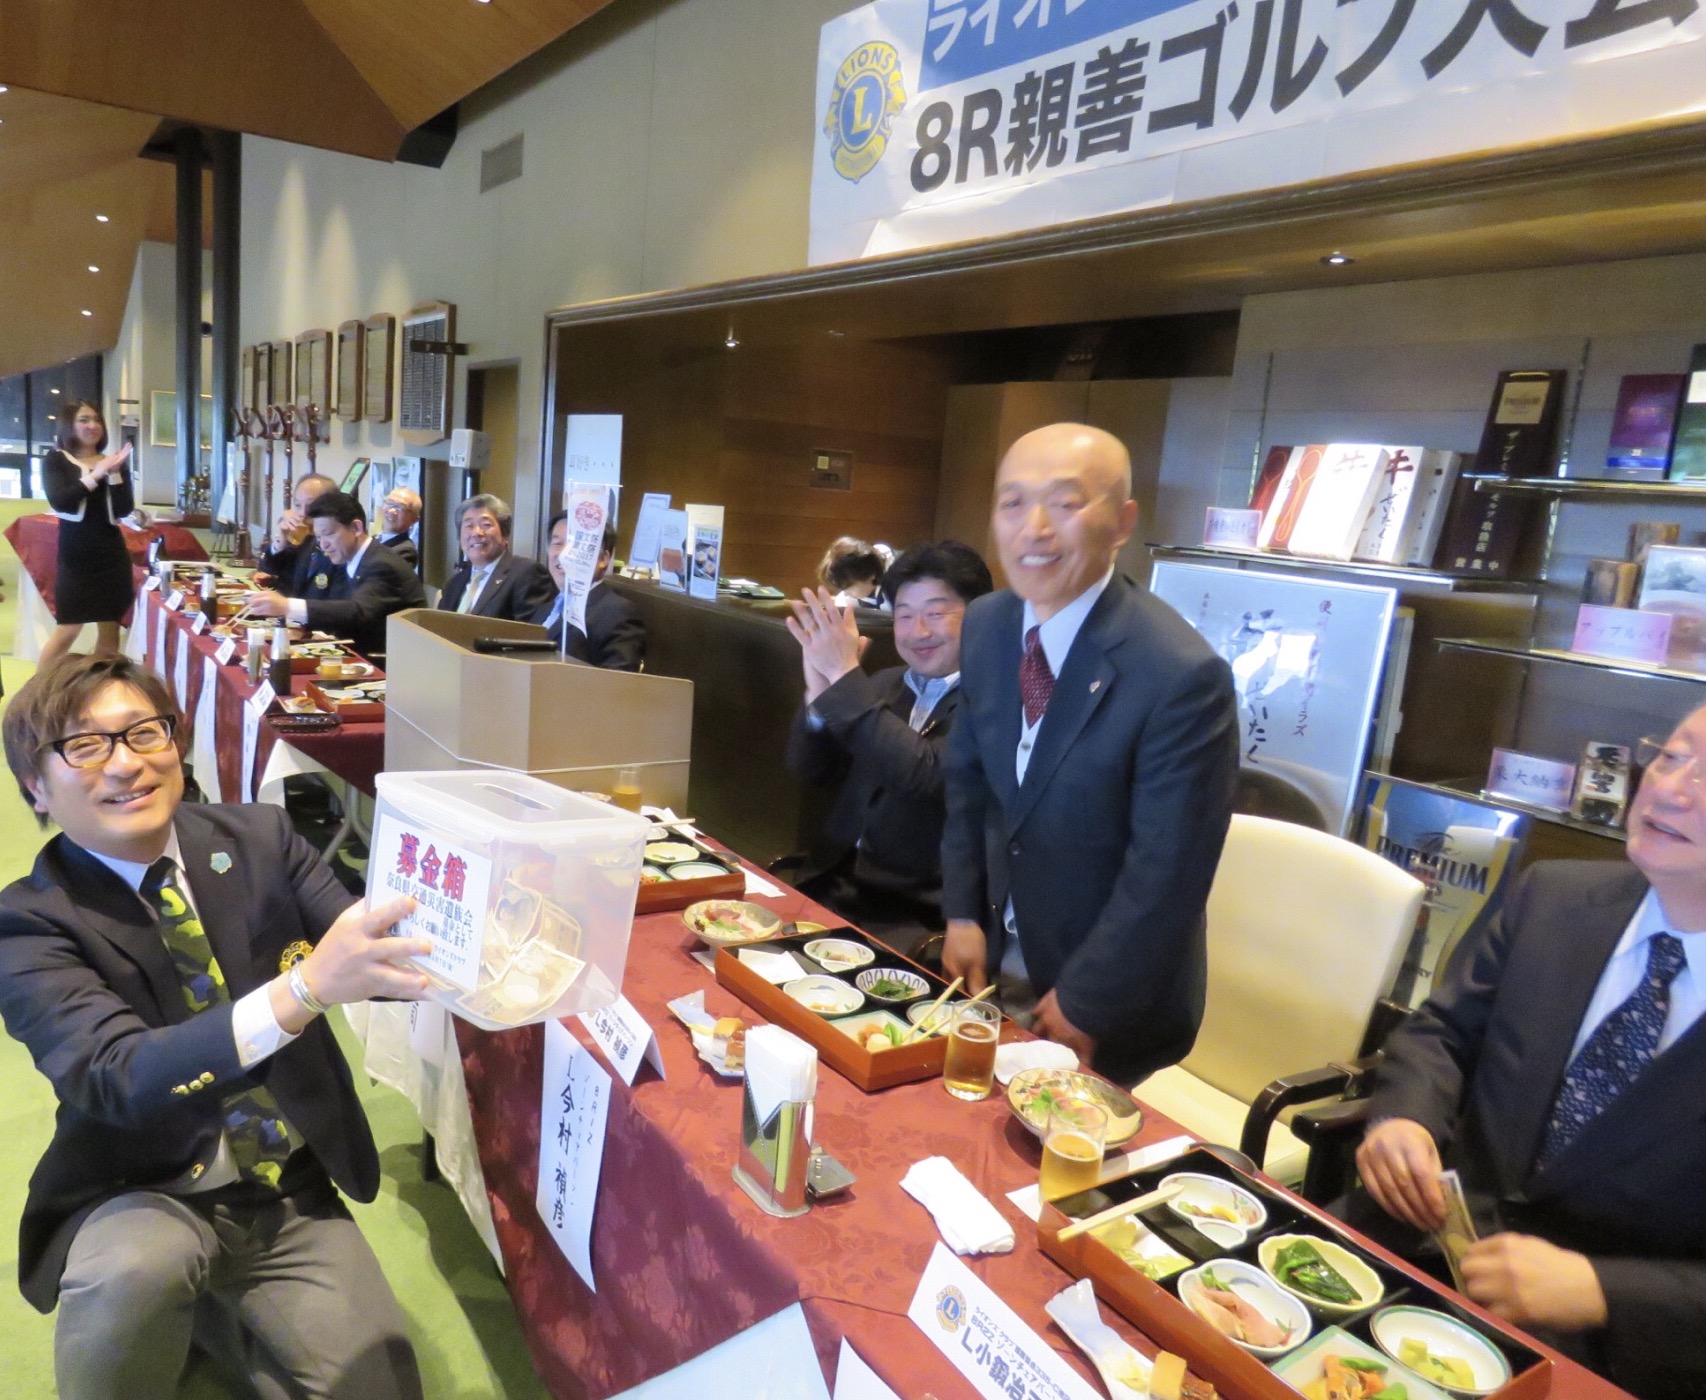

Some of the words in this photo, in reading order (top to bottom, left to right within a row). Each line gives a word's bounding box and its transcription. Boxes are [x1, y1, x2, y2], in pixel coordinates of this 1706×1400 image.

[928, 0, 1088, 63] ライ
[839, 46, 891, 82] LIONS
[851, 86, 873, 135] L
[1384, 449, 1414, 485] 牛
[396, 831, 468, 902] 募金箱
